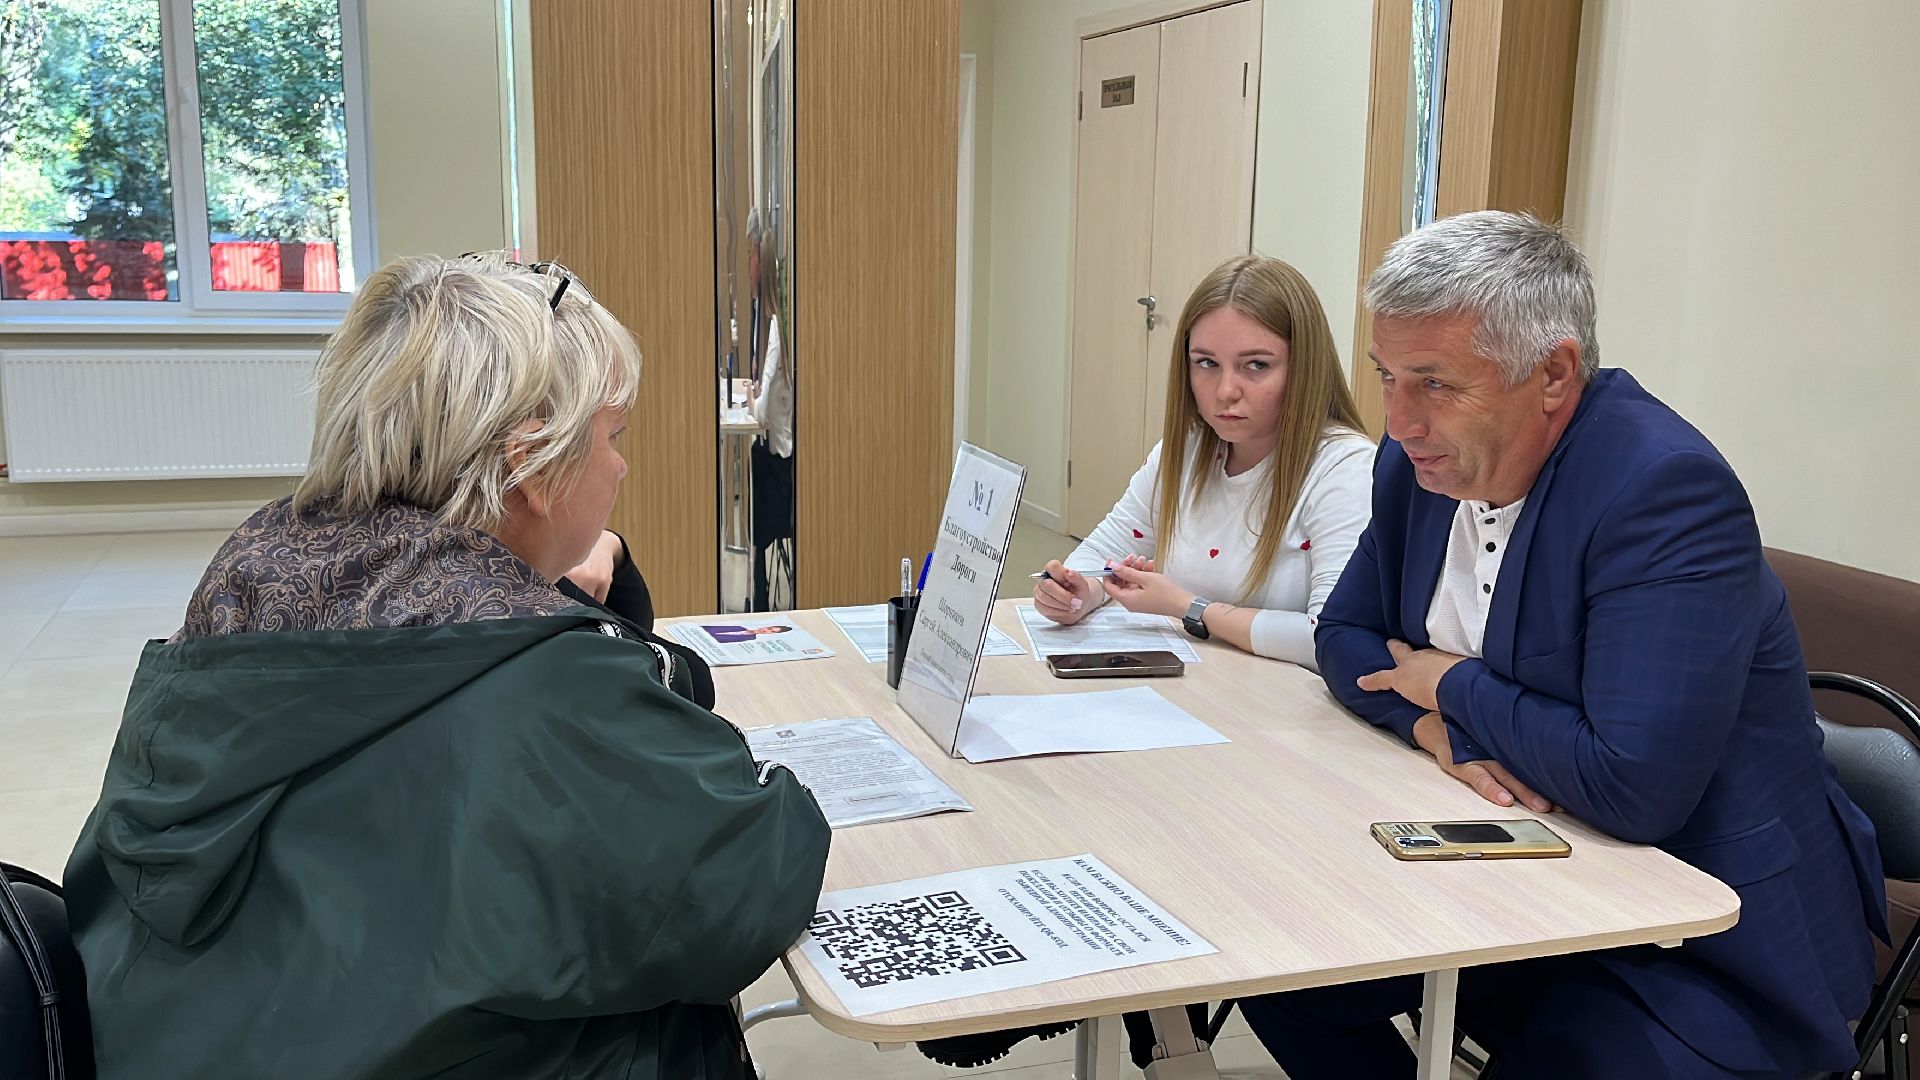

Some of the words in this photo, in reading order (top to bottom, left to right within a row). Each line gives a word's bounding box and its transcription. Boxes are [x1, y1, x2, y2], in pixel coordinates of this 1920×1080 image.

[968, 480, 984, 512] №
[985, 488, 994, 517] 1
[944, 516, 1001, 563] Благоустройство
[951, 554, 977, 584] Дороги
[998, 888, 1046, 926] ОТСКАНИРУЙТЕ
[1030, 869, 1050, 882] ЕСЛИ
[1055, 890, 1082, 908] ХОТИТЕ
[1062, 873, 1082, 885] ЕСЛИ
[1092, 897, 1120, 916] ВОПРОС
[1117, 917, 1151, 942] ОСТАЛСЯ
[1073, 859, 1096, 872] НАМ
[1091, 873, 1125, 894] ВАЖНО
[1120, 895, 1150, 913] ВАШЕ
[1144, 914, 1191, 945] МНЕНИЕ!
[1045, 905, 1102, 949] АДМИНИСТРАЦИИ
[1089, 930, 1124, 956] ФОРМАТЕ
